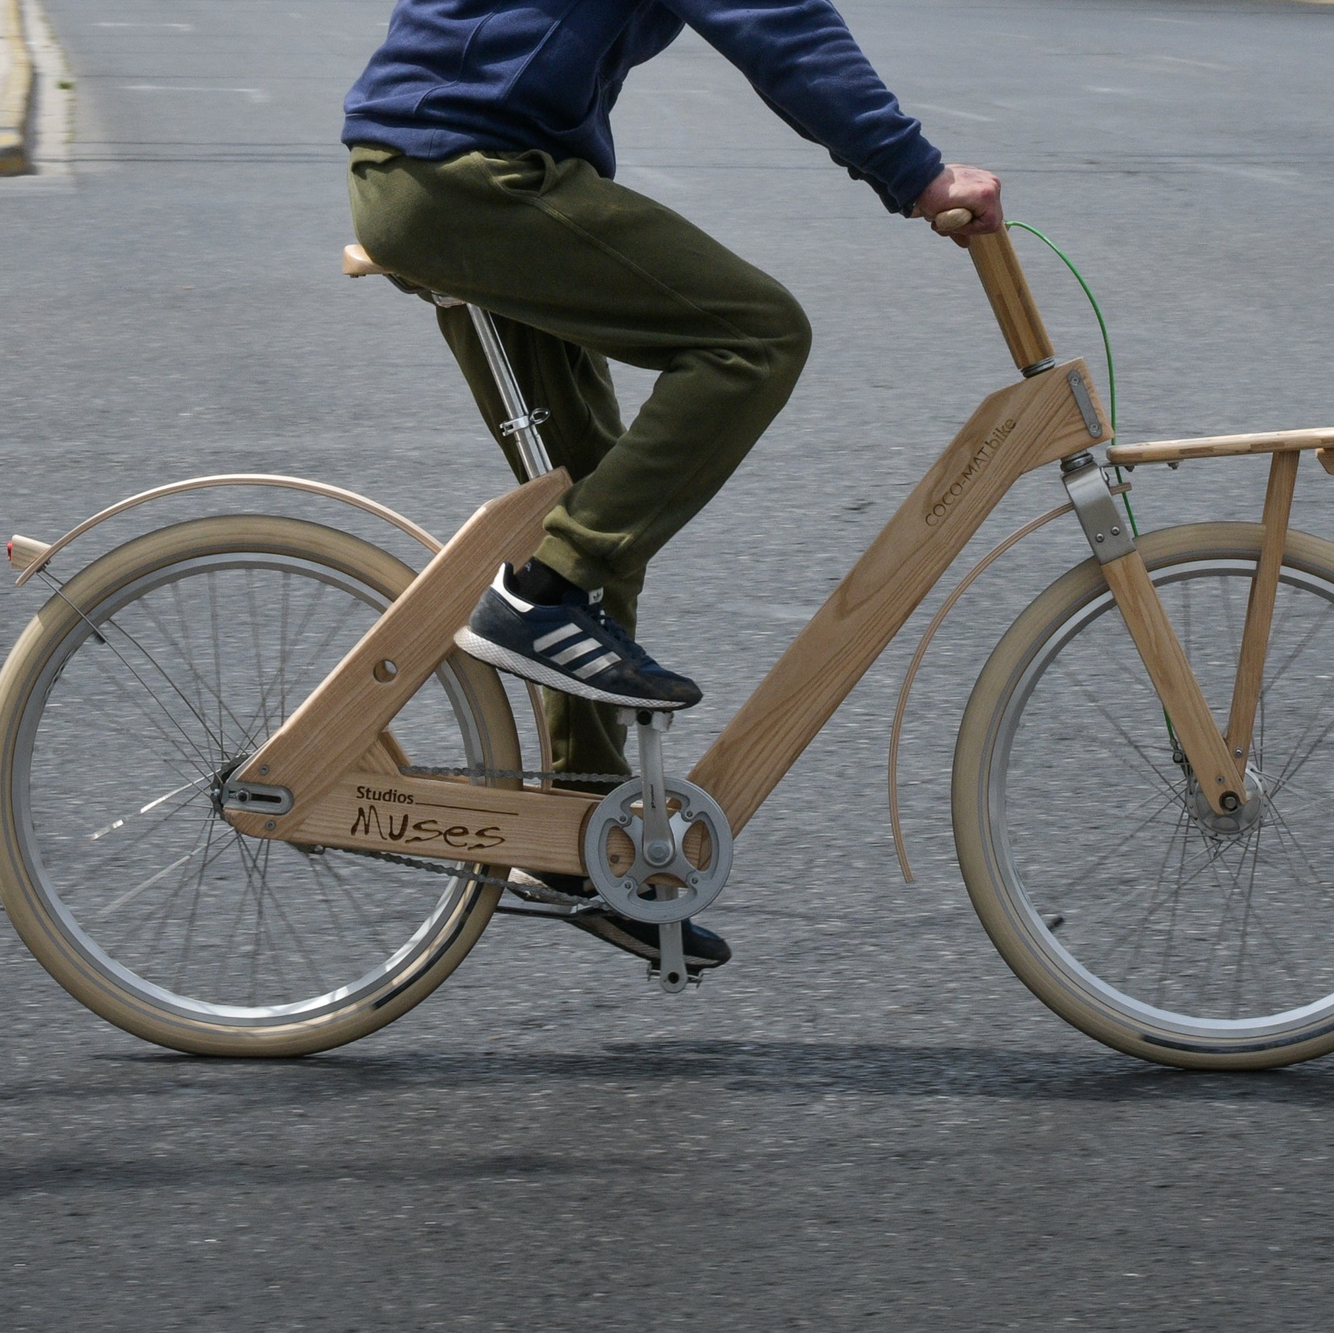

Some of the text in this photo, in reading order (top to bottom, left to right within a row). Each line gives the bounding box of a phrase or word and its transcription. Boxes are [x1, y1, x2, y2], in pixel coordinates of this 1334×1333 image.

[925, 418, 1017, 526] COCO-MAT bike
[356, 785, 414, 805] Studios
